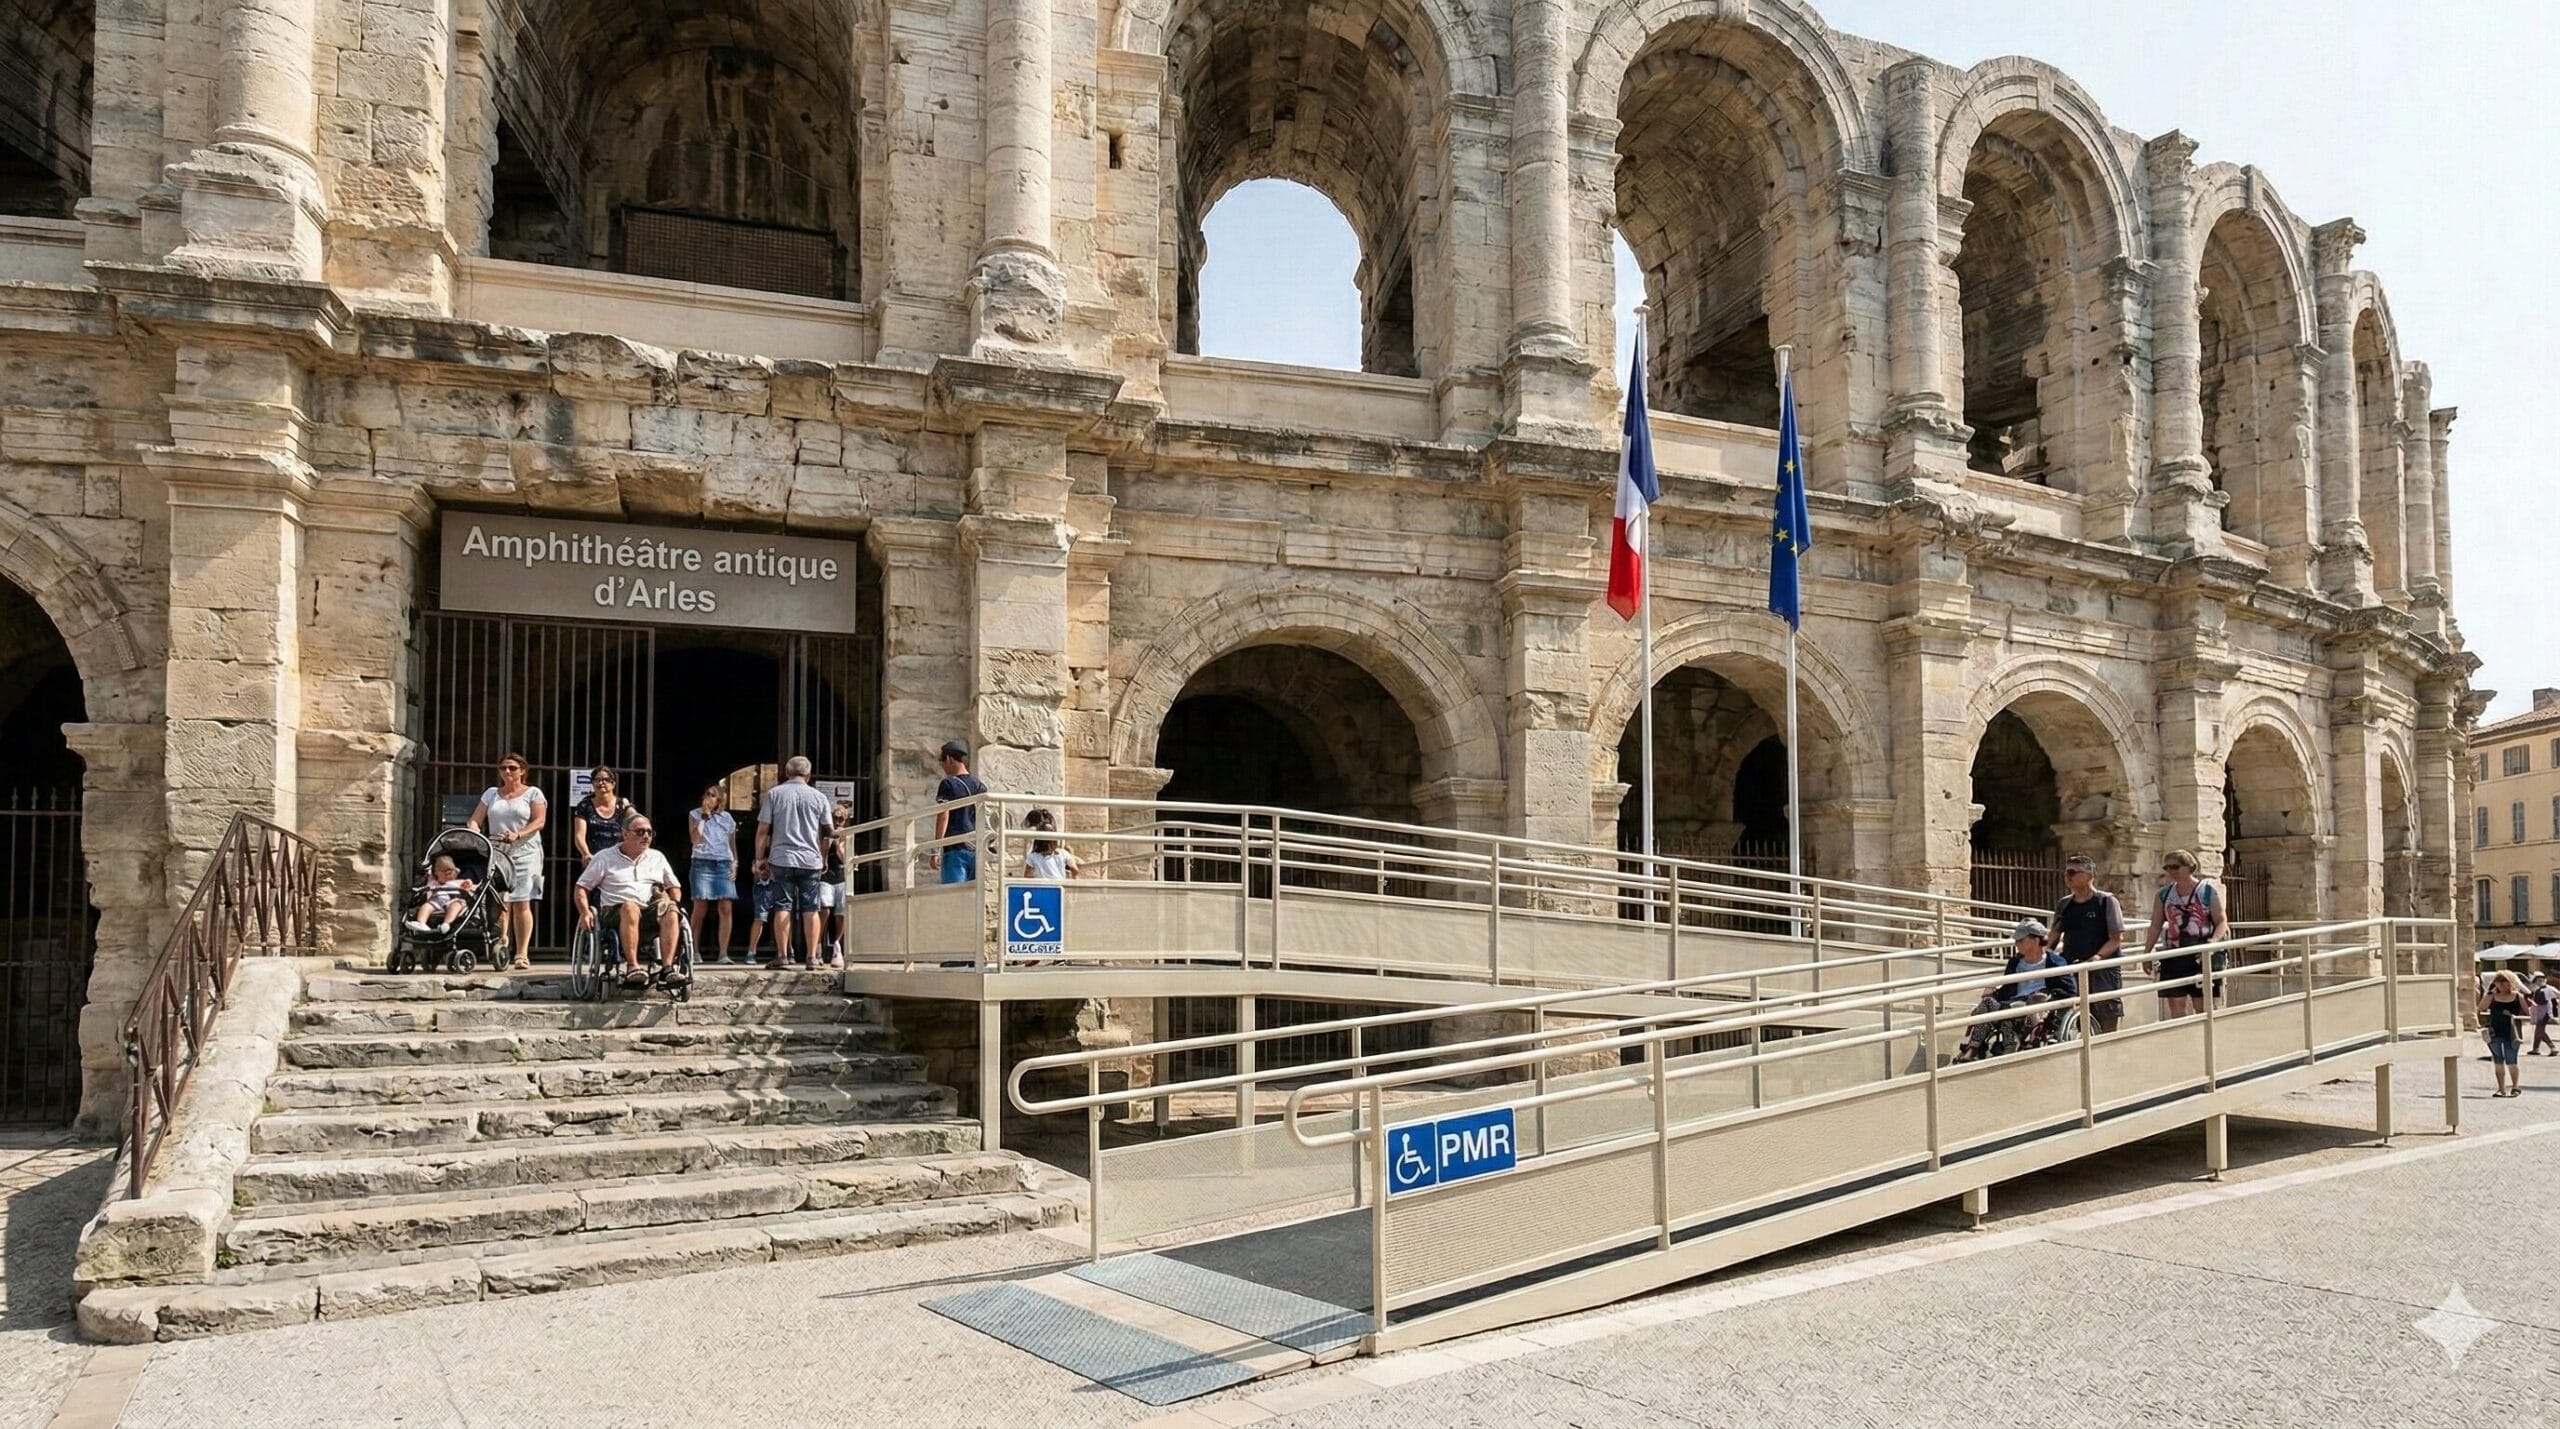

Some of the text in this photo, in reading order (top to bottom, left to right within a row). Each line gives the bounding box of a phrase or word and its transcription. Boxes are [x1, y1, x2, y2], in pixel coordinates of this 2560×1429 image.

[462, 525, 838, 586] Amphithéâtre antique
[594, 576, 717, 613] d’Arles
[1441, 1123, 1511, 1168] PMR
